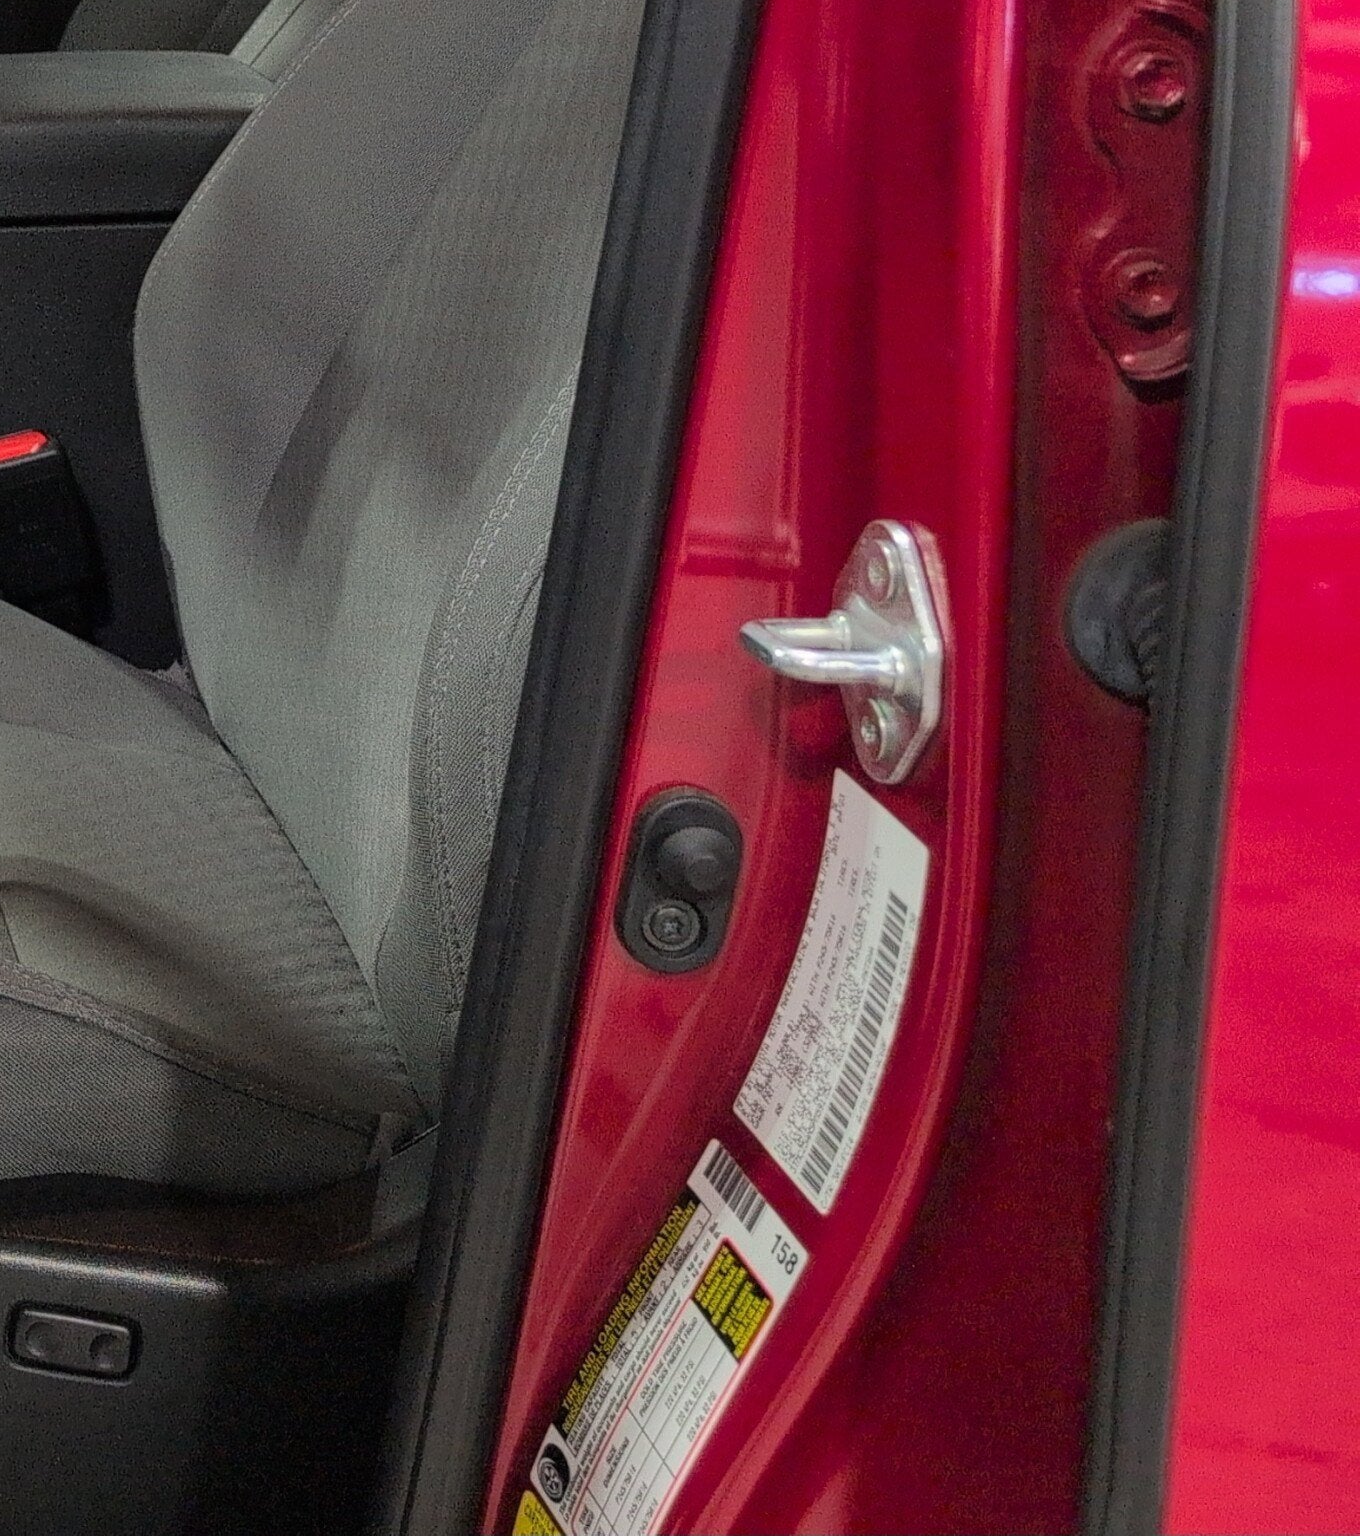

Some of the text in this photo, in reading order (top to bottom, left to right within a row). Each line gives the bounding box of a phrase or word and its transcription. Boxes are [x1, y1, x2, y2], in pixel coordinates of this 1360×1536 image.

[771, 1234, 798, 1274] 158
[561, 1203, 683, 1412] TIRE AND LOADING INFORMATION
[615, 1345, 630, 1371] TOTAL
